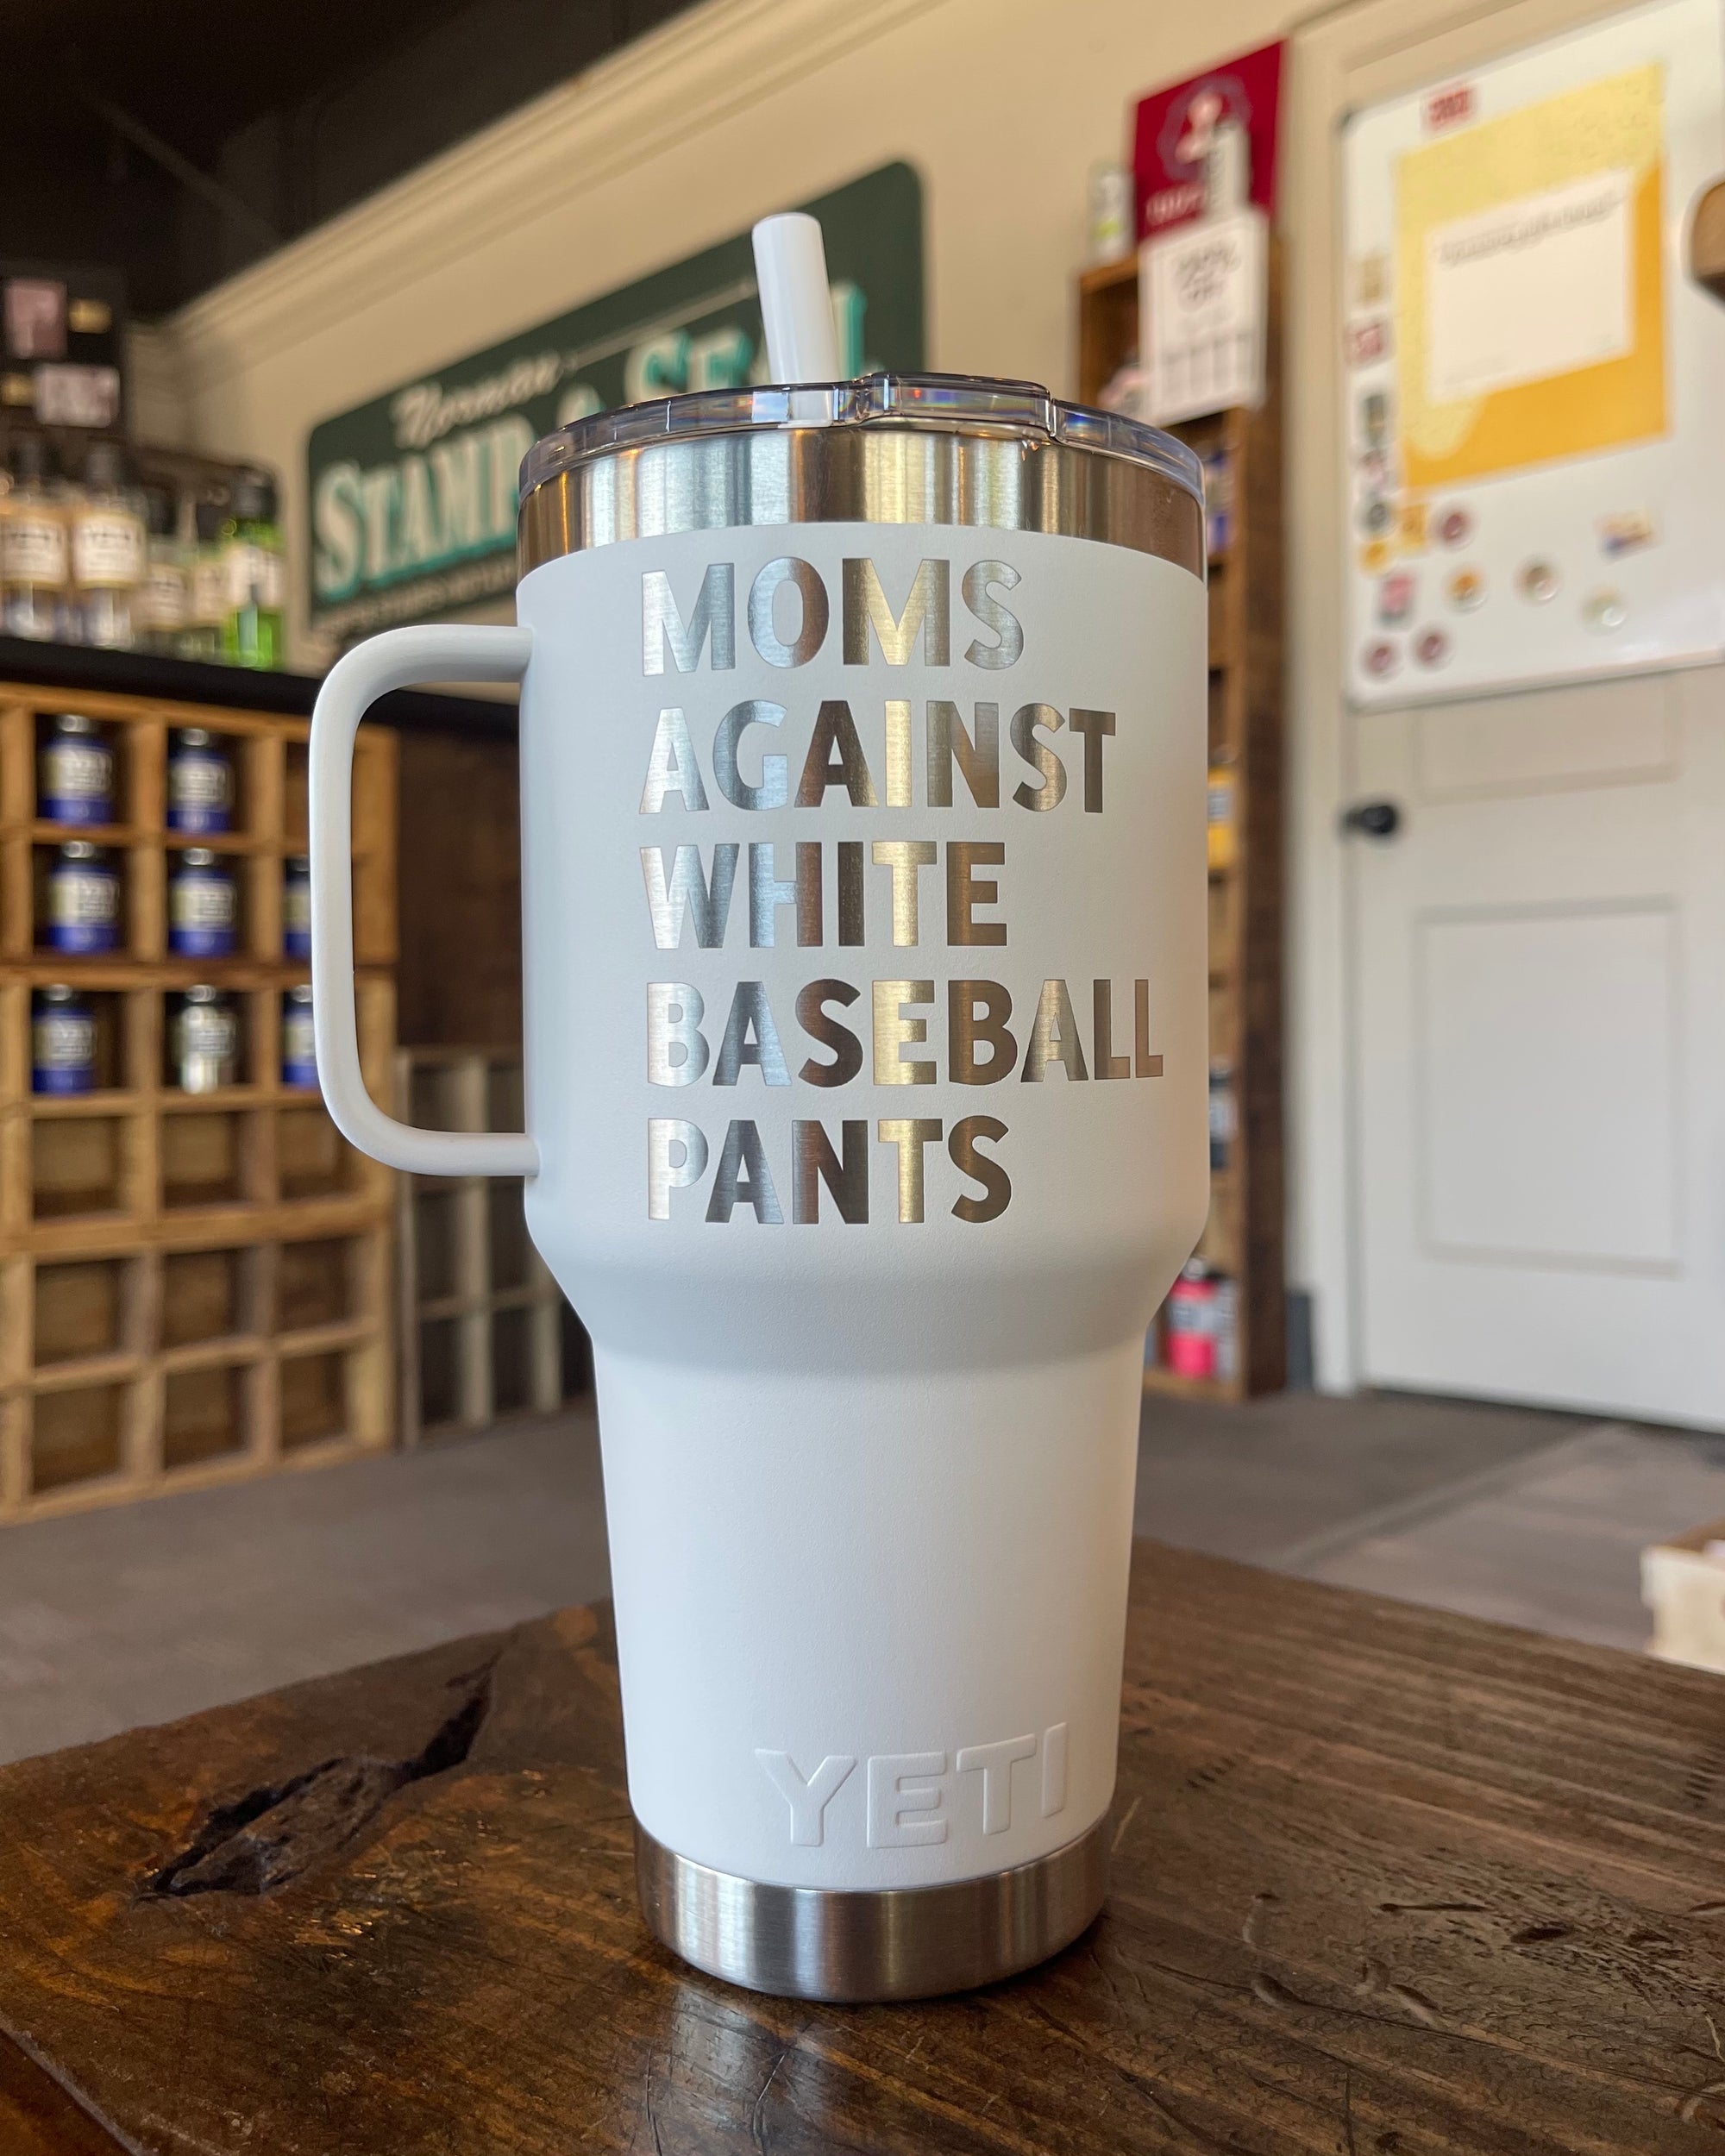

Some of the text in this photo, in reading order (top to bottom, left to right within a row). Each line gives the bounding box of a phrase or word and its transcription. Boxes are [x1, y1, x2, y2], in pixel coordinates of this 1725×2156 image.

[641, 556, 1025, 677] MOMS
[639, 699, 1116, 815] AGAINST
[639, 841, 1007, 950] WHITE
[647, 978, 1164, 1088] BASEBALL
[648, 1115, 1013, 1225] PANTS
[755, 1722, 1069, 1849] YETI
